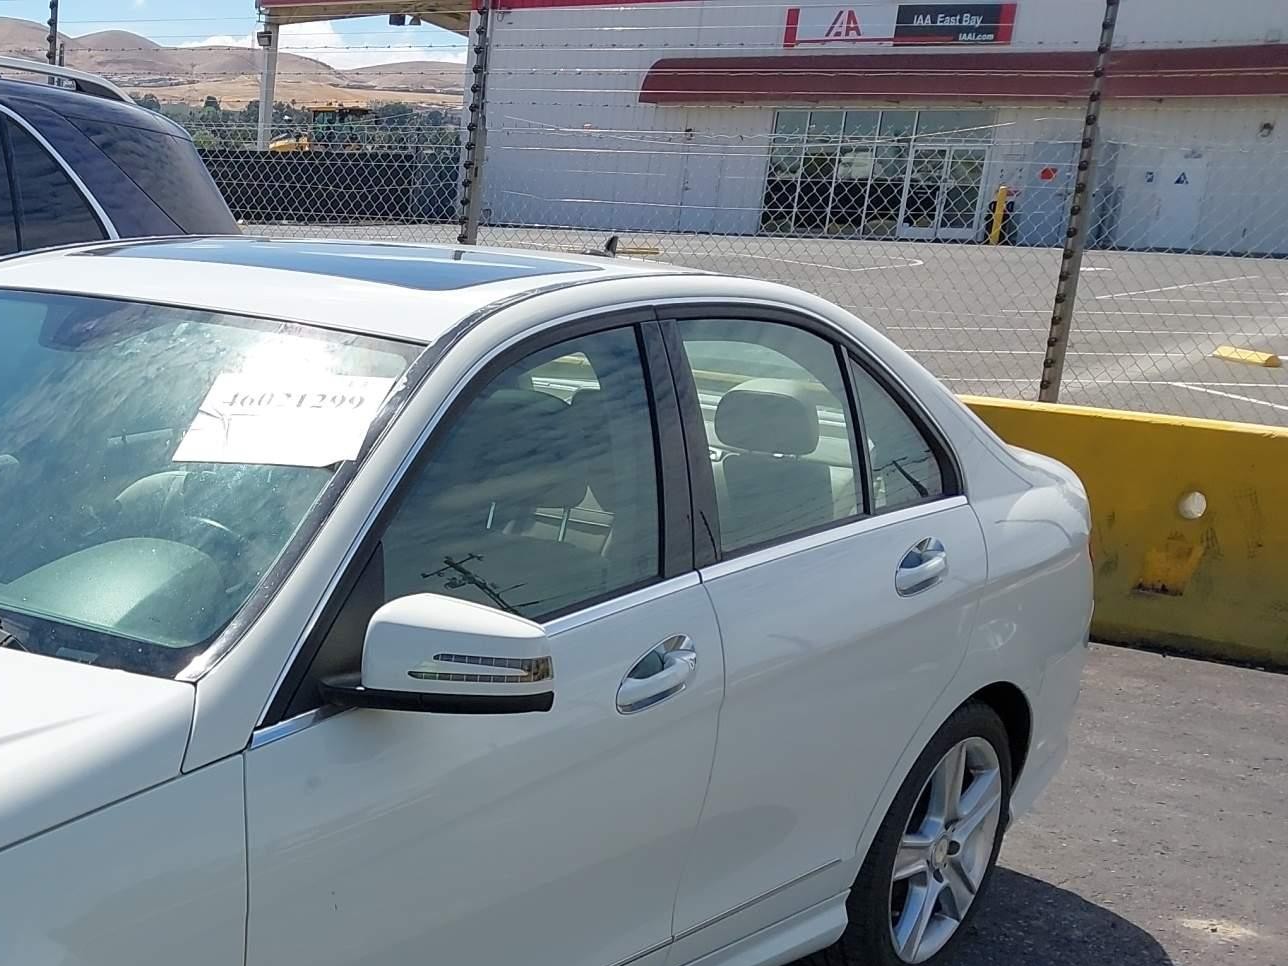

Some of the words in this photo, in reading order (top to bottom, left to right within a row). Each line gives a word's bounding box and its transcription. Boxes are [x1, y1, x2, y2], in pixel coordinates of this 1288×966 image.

[913, 14, 932, 25] IAA
[937, 14, 961, 25] East
[962, 13, 984, 28] Bay
[958, 32, 995, 41] IAAI.com
[222, 391, 366, 409] 46021299
